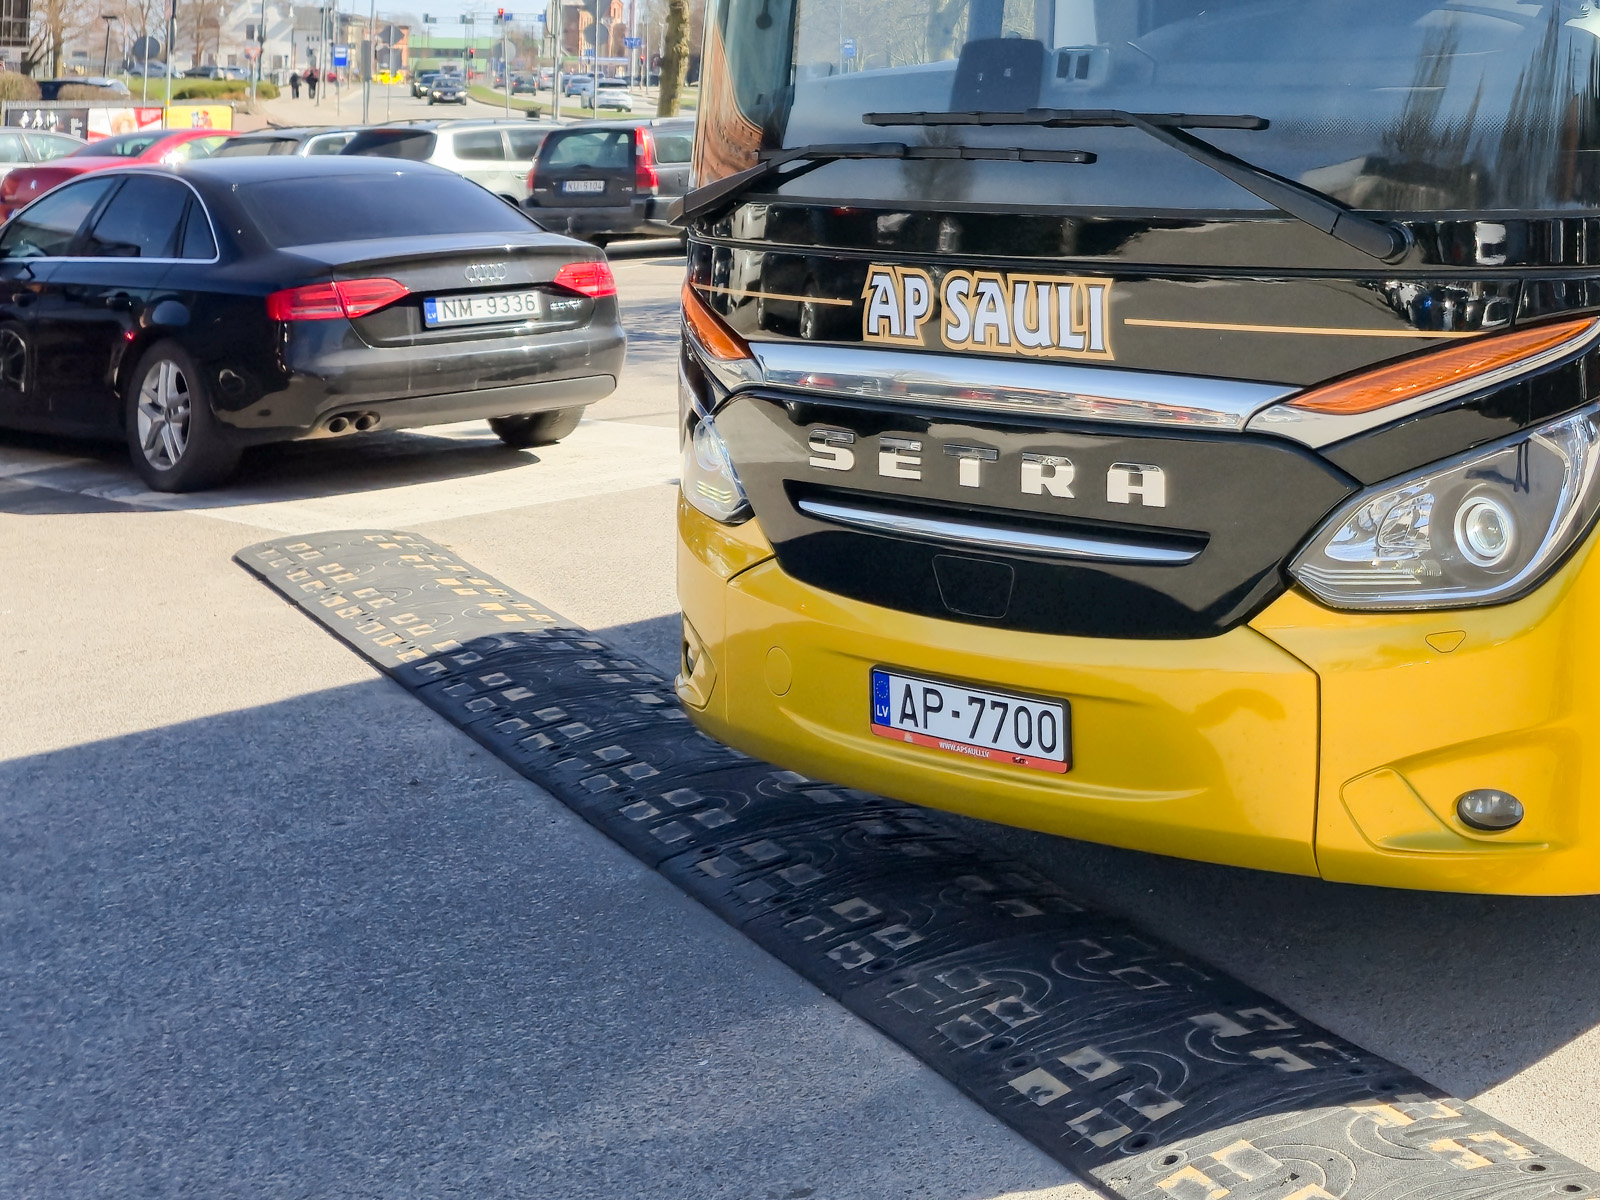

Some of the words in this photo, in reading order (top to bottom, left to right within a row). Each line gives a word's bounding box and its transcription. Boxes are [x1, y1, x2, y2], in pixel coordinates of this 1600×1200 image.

[442, 293, 536, 319] NM-9336
[866, 272, 931, 340] AP
[944, 276, 1108, 353] SAULI
[807, 427, 1167, 508] SETRA
[876, 703, 889, 718] LV
[898, 683, 1057, 754] AP-7700
